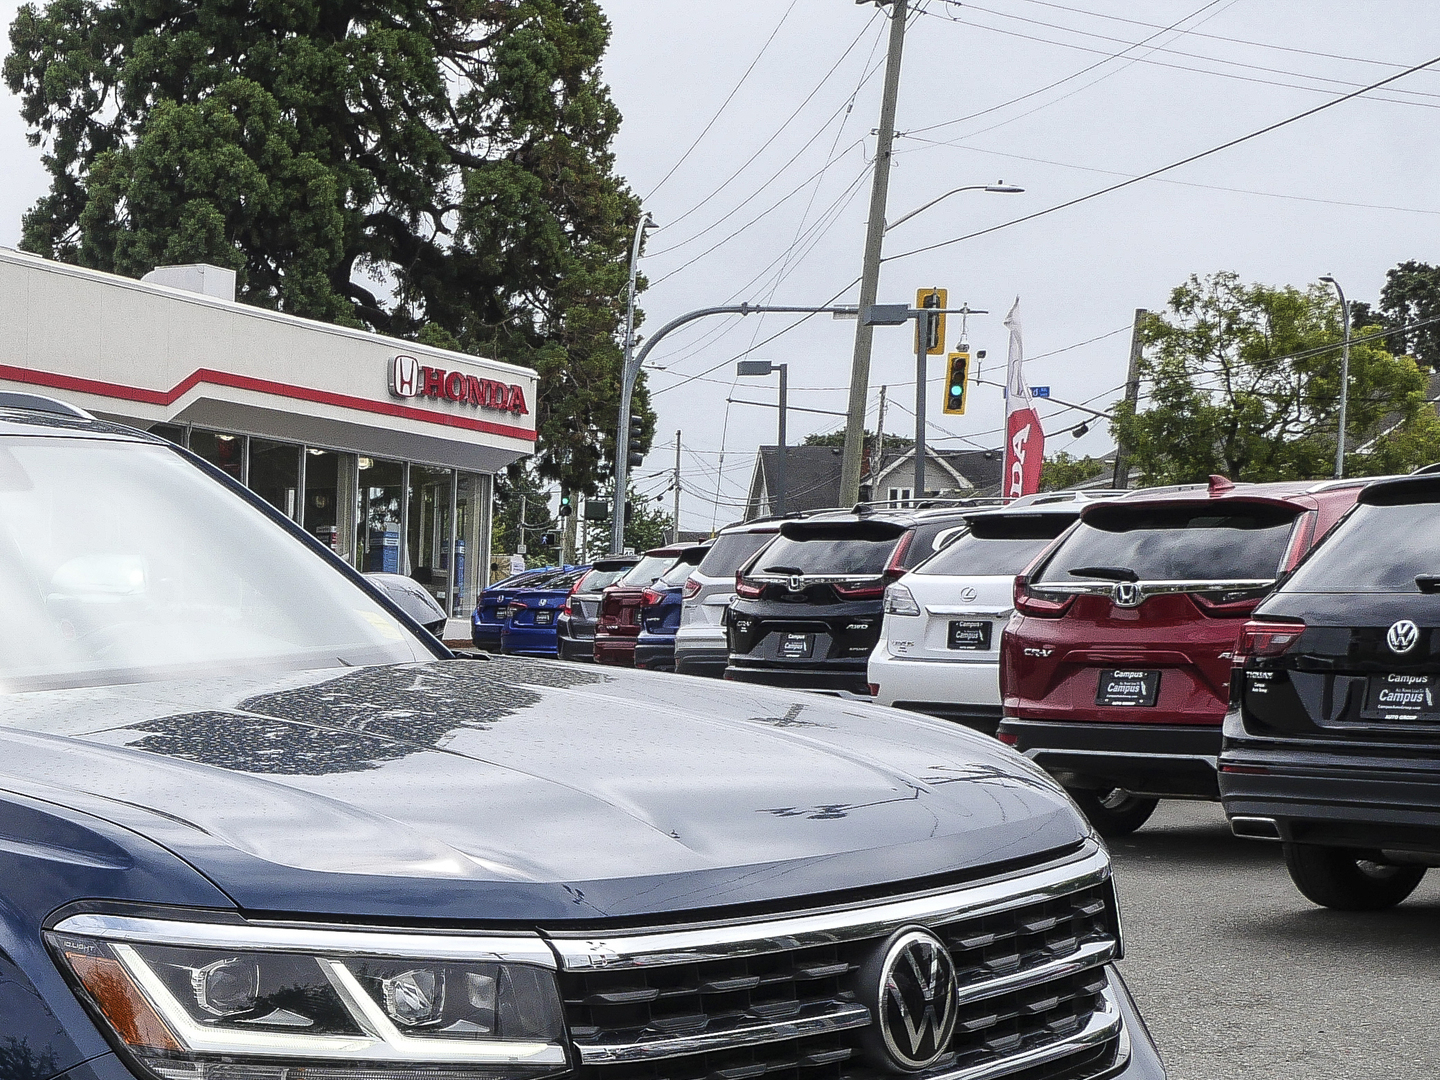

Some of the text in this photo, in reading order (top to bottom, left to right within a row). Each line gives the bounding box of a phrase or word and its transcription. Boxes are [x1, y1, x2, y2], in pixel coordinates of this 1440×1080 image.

[421, 365, 529, 415] HONDA
[1114, 670, 1144, 679] Campus
[1387, 673, 1428, 685] Campus
[1107, 682, 1140, 694] Campus
[1379, 689, 1423, 705] Campus
